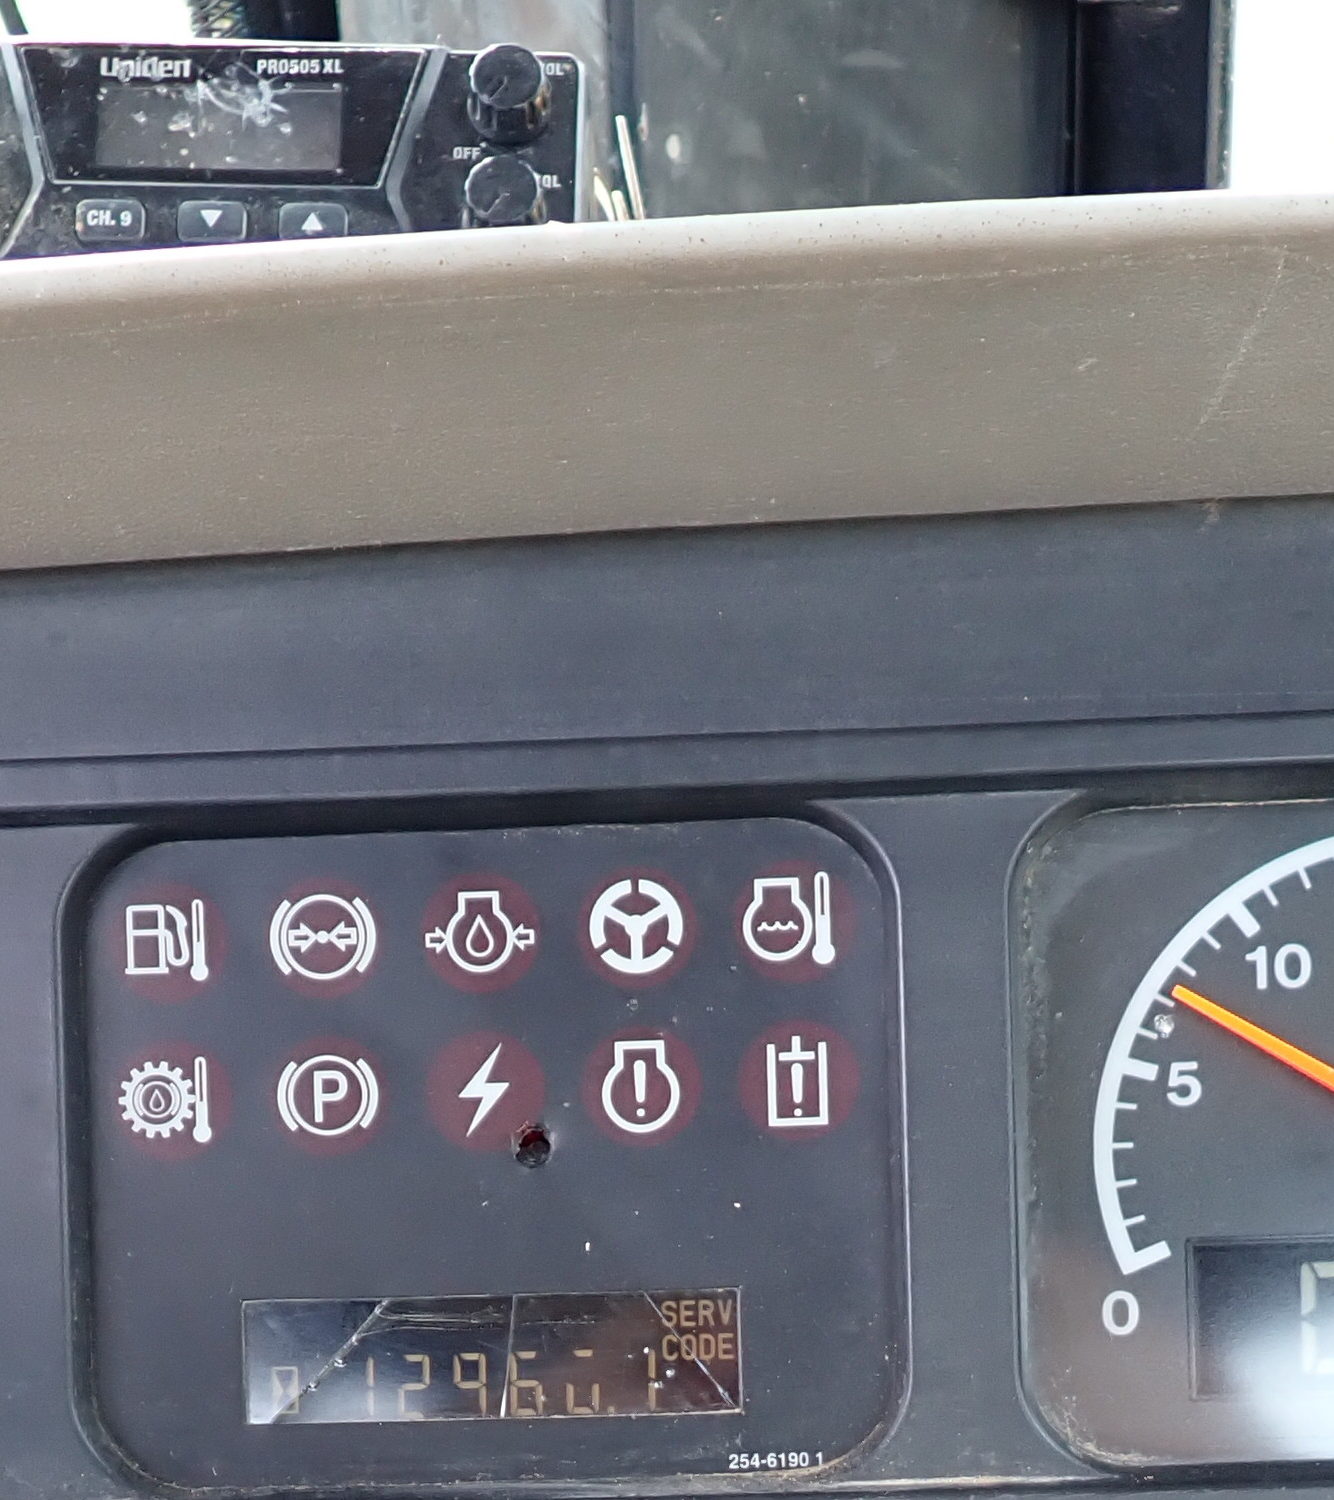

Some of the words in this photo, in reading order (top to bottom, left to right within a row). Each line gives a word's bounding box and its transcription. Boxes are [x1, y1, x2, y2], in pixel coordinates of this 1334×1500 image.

[100, 57, 192, 79] Uniden
[322, 59, 344, 75] XL
[540, 63, 565, 76] OL
[452, 146, 482, 160] OFF
[536, 174, 561, 188] QL
[86, 209, 116, 226] CH.
[120, 210, 132, 227] 9
[1245, 943, 1312, 990] 10
[1166, 1061, 1203, 1107] 5
[661, 1300, 733, 1328] SERV
[1101, 1290, 1140, 1335] 0
[661, 1333, 735, 1361] CODE
[728, 1452, 809, 1469] 254-6190
